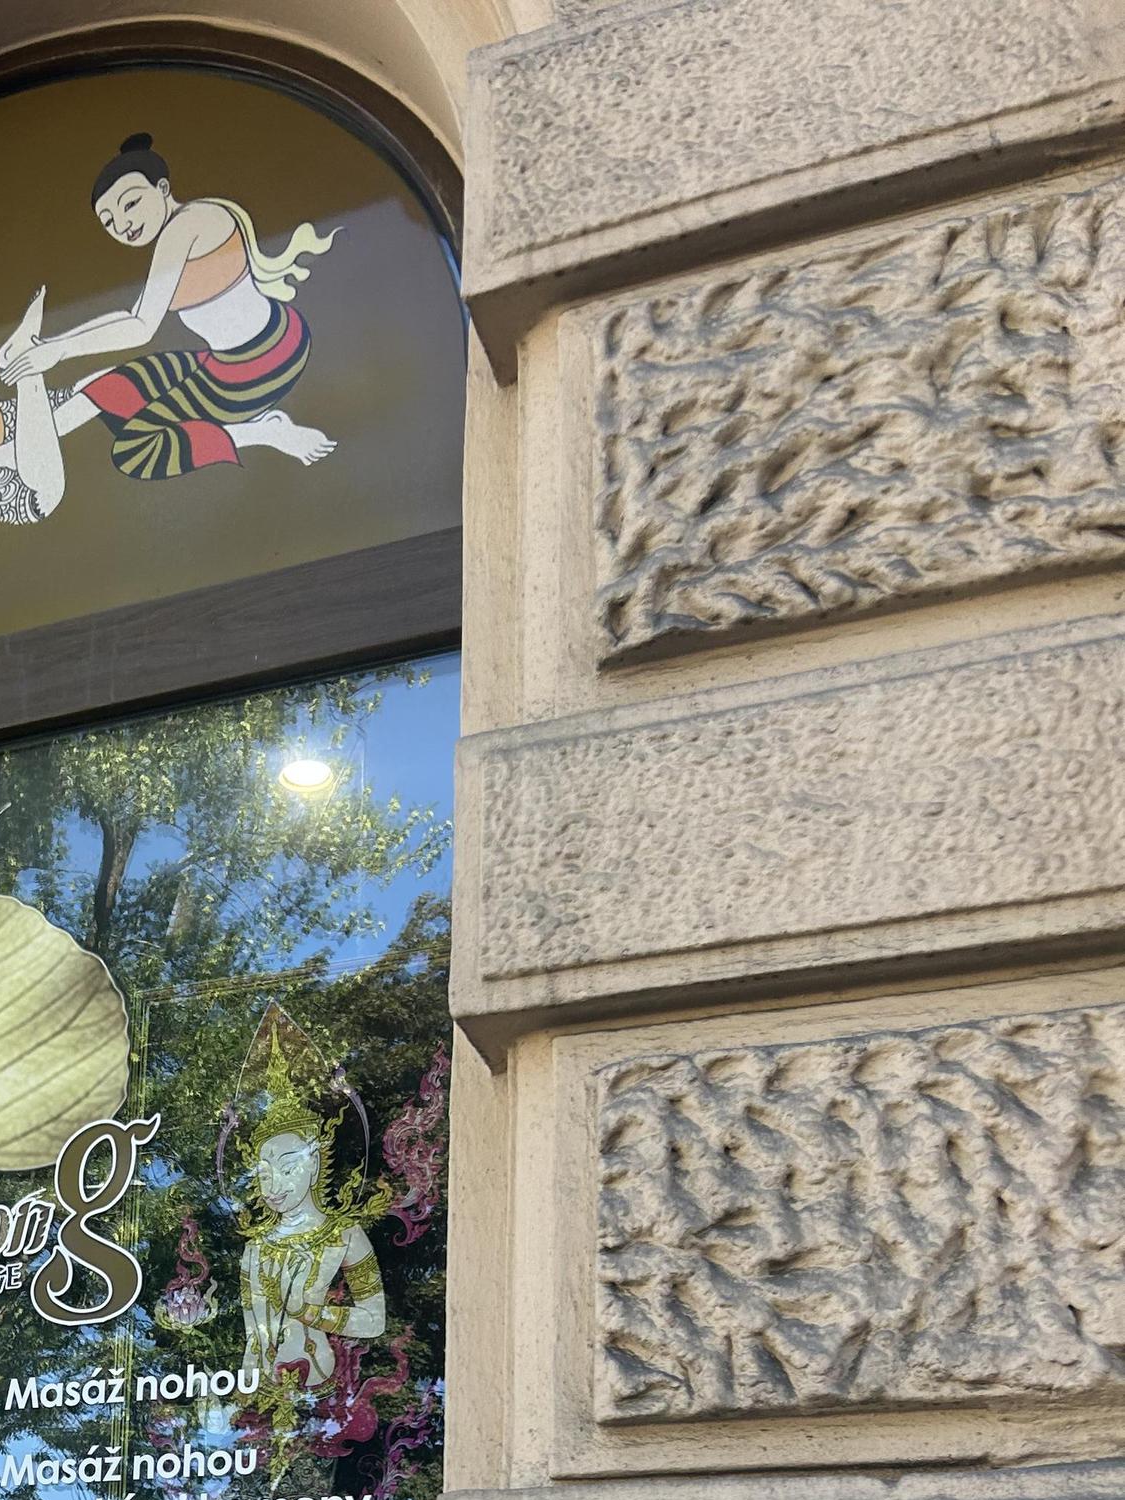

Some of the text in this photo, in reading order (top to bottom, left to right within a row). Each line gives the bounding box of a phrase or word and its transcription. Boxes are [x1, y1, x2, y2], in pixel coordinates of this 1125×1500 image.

[4, 1364, 261, 1411] Masáž nohou
[1, 1444, 257, 1487] Masáž nohou
